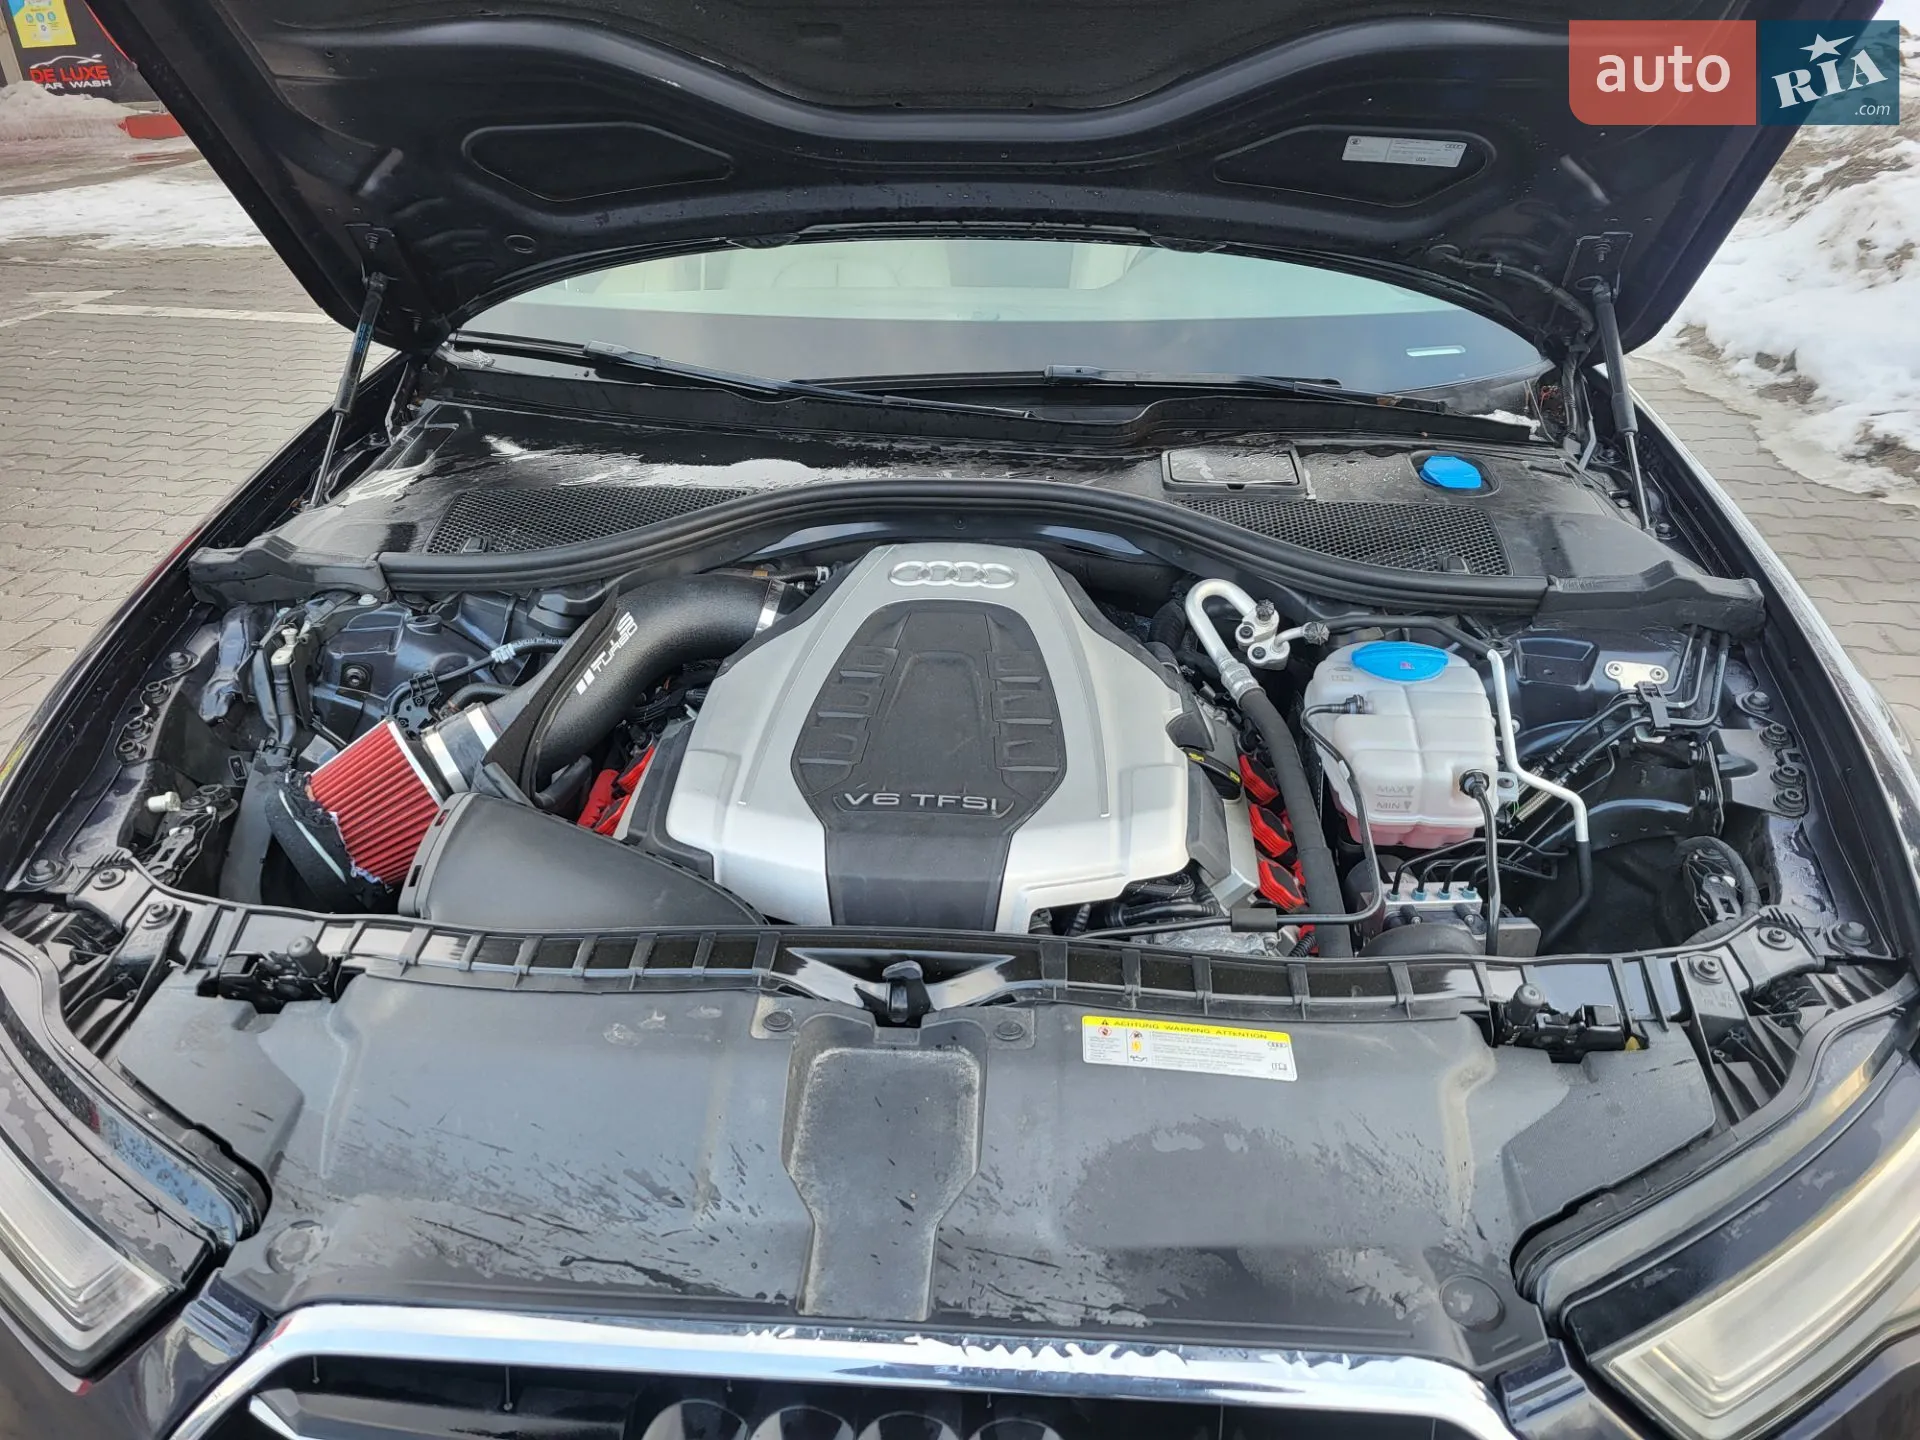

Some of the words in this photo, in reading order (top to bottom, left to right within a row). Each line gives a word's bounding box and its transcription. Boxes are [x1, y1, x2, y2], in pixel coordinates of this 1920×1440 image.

[30, 67, 56, 83] DE
[60, 65, 109, 82] LUXE
[44, 82, 64, 90] AR
[70, 79, 112, 88] WASH
[593, 622, 638, 672] TURBO
[1376, 785, 1405, 793] MAX
[844, 793, 900, 806] V6
[911, 794, 996, 811] TFSI
[1114, 1021, 1159, 1029] ACHTUNG
[1163, 1025, 1210, 1034] WARNING
[1215, 1030, 1267, 1039] ATTENTION
